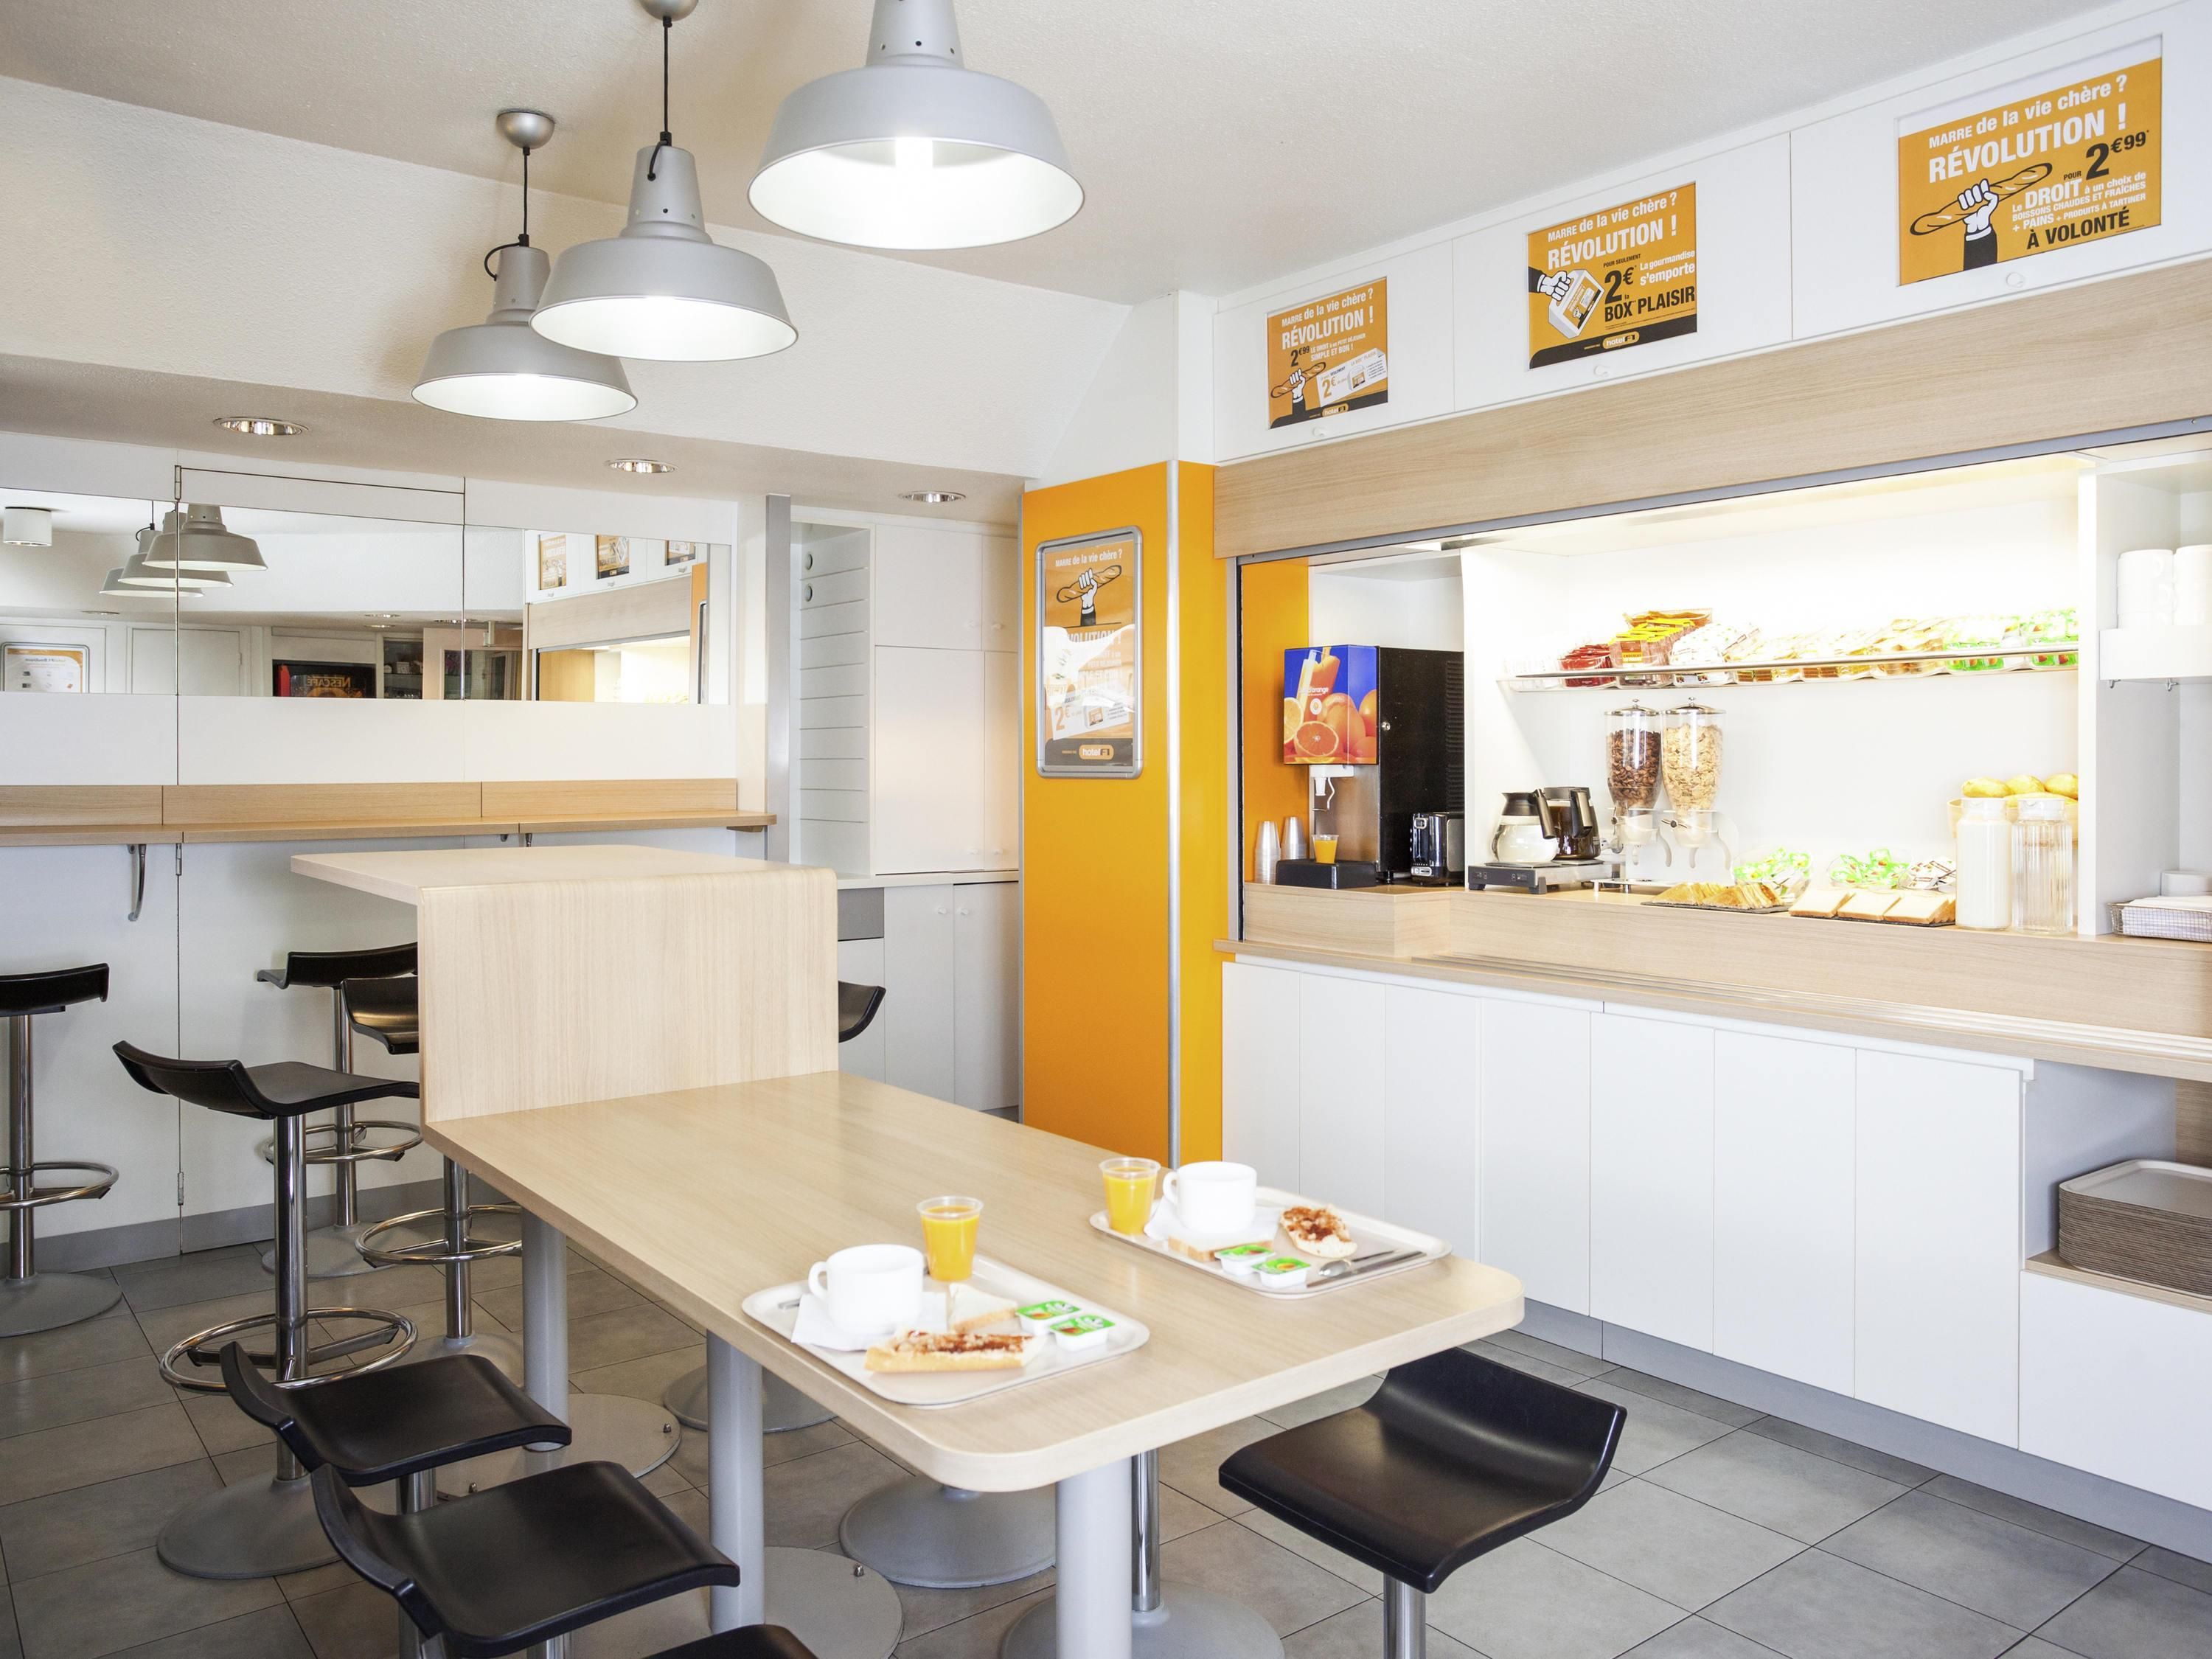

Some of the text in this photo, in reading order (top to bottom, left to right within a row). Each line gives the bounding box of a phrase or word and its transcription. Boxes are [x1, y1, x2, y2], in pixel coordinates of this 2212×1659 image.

[1929, 125, 1972, 149] MARRE
[1976, 116, 1997, 134] de
[2003, 109, 2019, 128] la
[2025, 100, 2051, 120] vie
[2057, 79, 2111, 111] chère
[1929, 108, 2105, 184] RÉVOLUTION
[2012, 172, 2146, 213] Le DROIT à un choix de
[2064, 170, 2081, 180] POUR
[2012, 181, 2146, 221] BOISSONS CHAUDES ET FRAÎCHES
[2023, 214, 2054, 230] PAINS
[2064, 204, 2100, 220] PRODUITS
[2109, 193, 2146, 208] TARTINER
[1548, 226, 1577, 242] MARRE
[1579, 220, 1593, 233] de
[1597, 215, 1607, 228] la
[1611, 209, 1629, 223] vie
[1632, 198, 1667, 217] chère
[2027, 206, 2130, 249] À VOLONTÉ
[1548, 218, 1663, 271] RÉVOLUTION
[1615, 254, 1641, 265] SEULEMENT
[1640, 250, 1695, 271] La gourmandise
[1640, 262, 1695, 286] s'emporte
[1281, 313, 1303, 327] MARRE
[1304, 308, 1314, 320] de
[1316, 305, 1324, 316] la
[1327, 300, 1339, 312] vie
[1342, 291, 1366, 308] chère
[1638, 286, 1695, 313] PLAISIR
[1282, 308, 1363, 349] RÉVOLUTION
[1311, 349, 1329, 361] SIMPLE
[1331, 347, 1338, 355] ET
[1072, 555, 1080, 565] de
[1081, 554, 1087, 563] la
[1088, 552, 1098, 562] vie
[1099, 549, 1117, 560] chère
